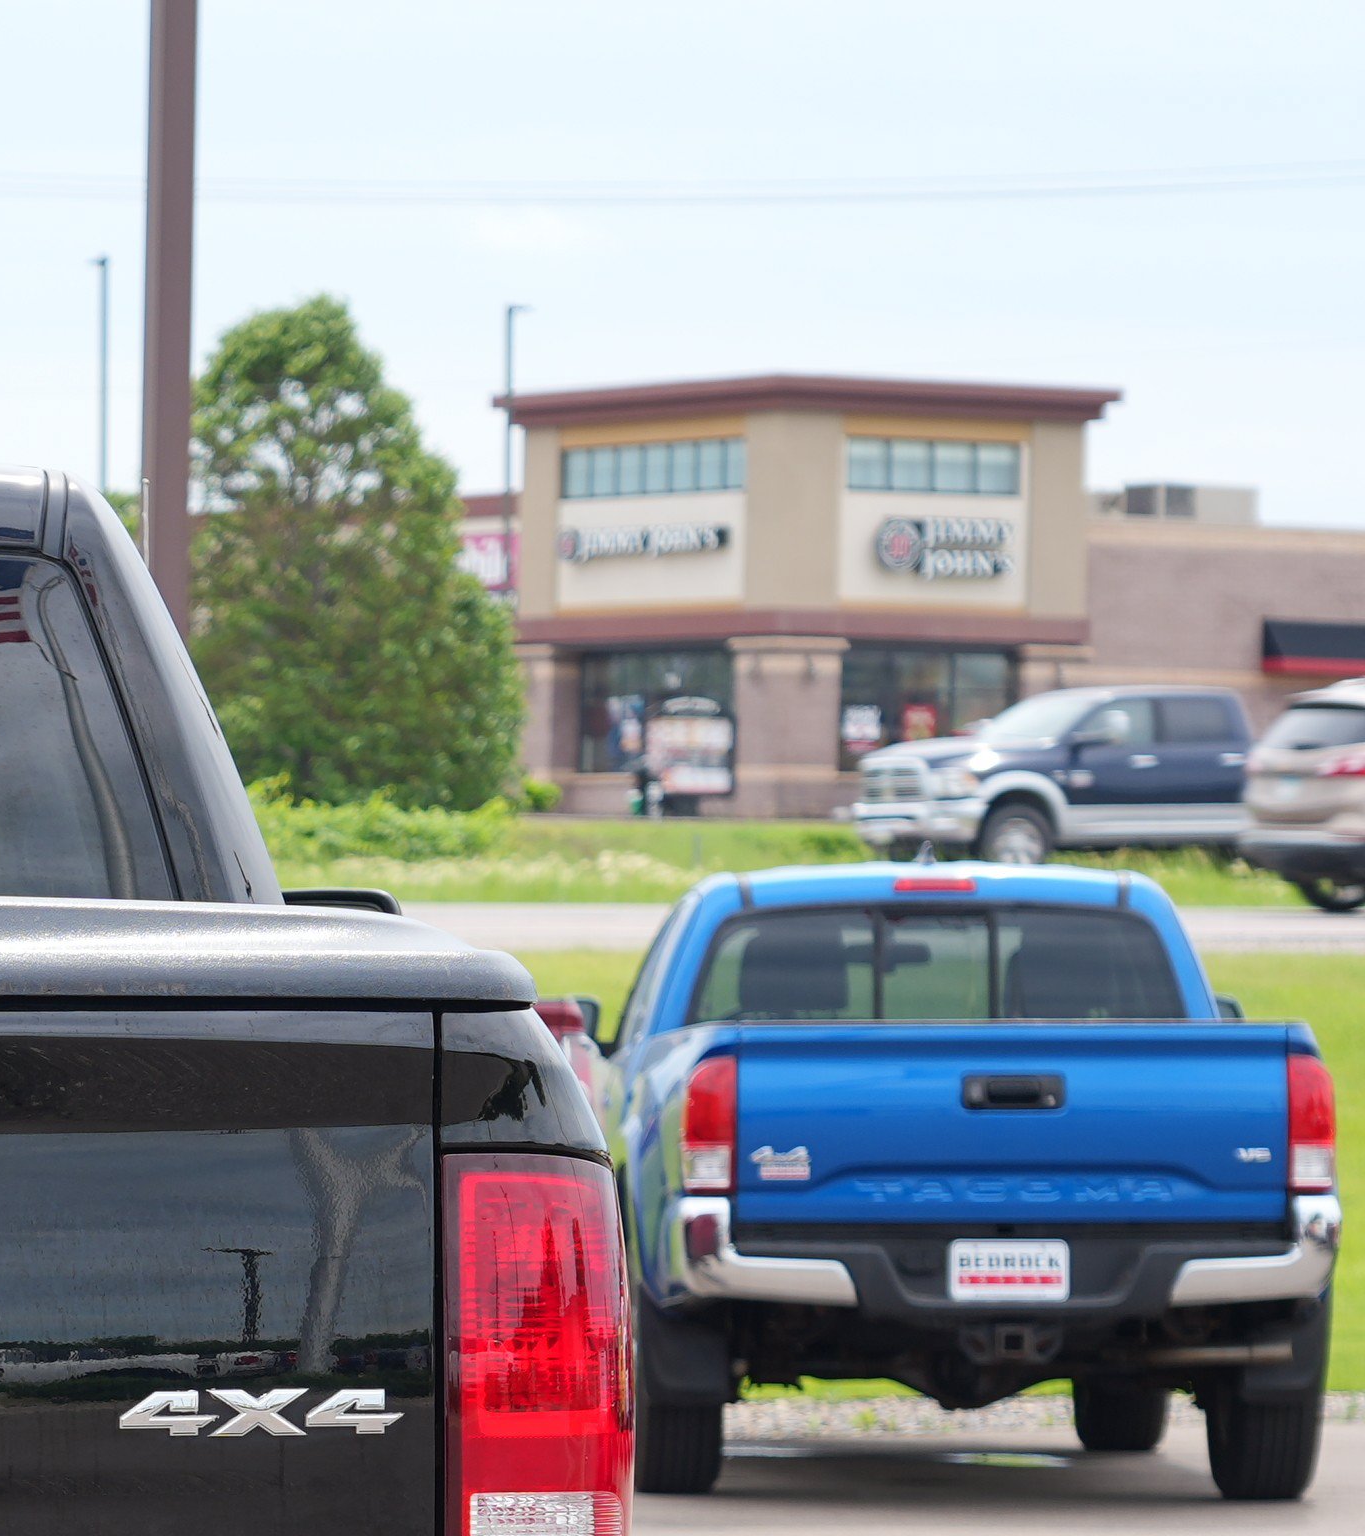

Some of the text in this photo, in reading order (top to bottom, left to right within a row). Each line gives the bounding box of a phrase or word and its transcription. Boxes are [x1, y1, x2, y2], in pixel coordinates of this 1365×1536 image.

[923, 516, 1014, 548] JIMMY
[920, 548, 1014, 580] JOHN'S
[855, 1179, 1175, 1204] TACOMA
[958, 1253, 1062, 1269] BEDROCK
[118, 1387, 404, 1437] 4X4
